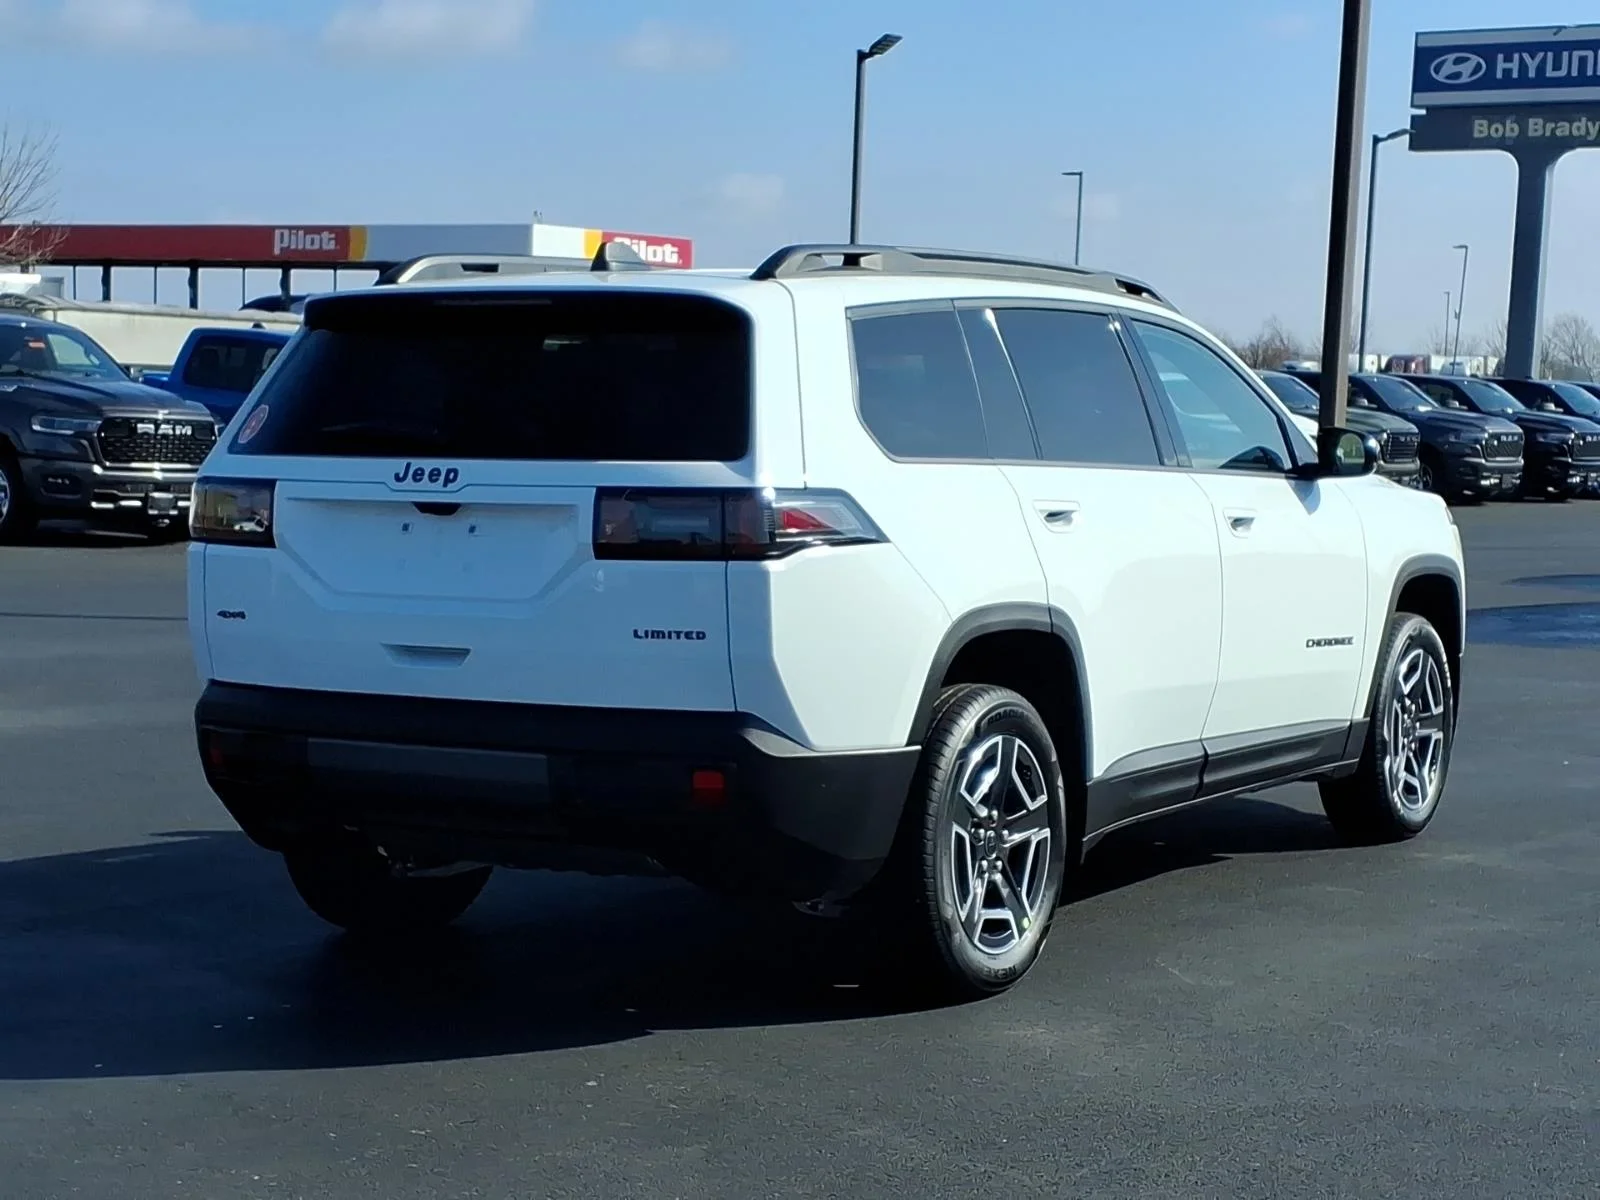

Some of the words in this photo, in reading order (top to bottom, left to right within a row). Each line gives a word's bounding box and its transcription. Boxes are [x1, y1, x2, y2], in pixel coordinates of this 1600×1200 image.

[1473, 119, 1519, 138] Bob
[1528, 117, 1600, 140] Brady
[274, 229, 336, 255] Pilot
[137, 424, 192, 435] RAM
[394, 462, 459, 488] Jeep
[633, 629, 706, 640] LIMITED
